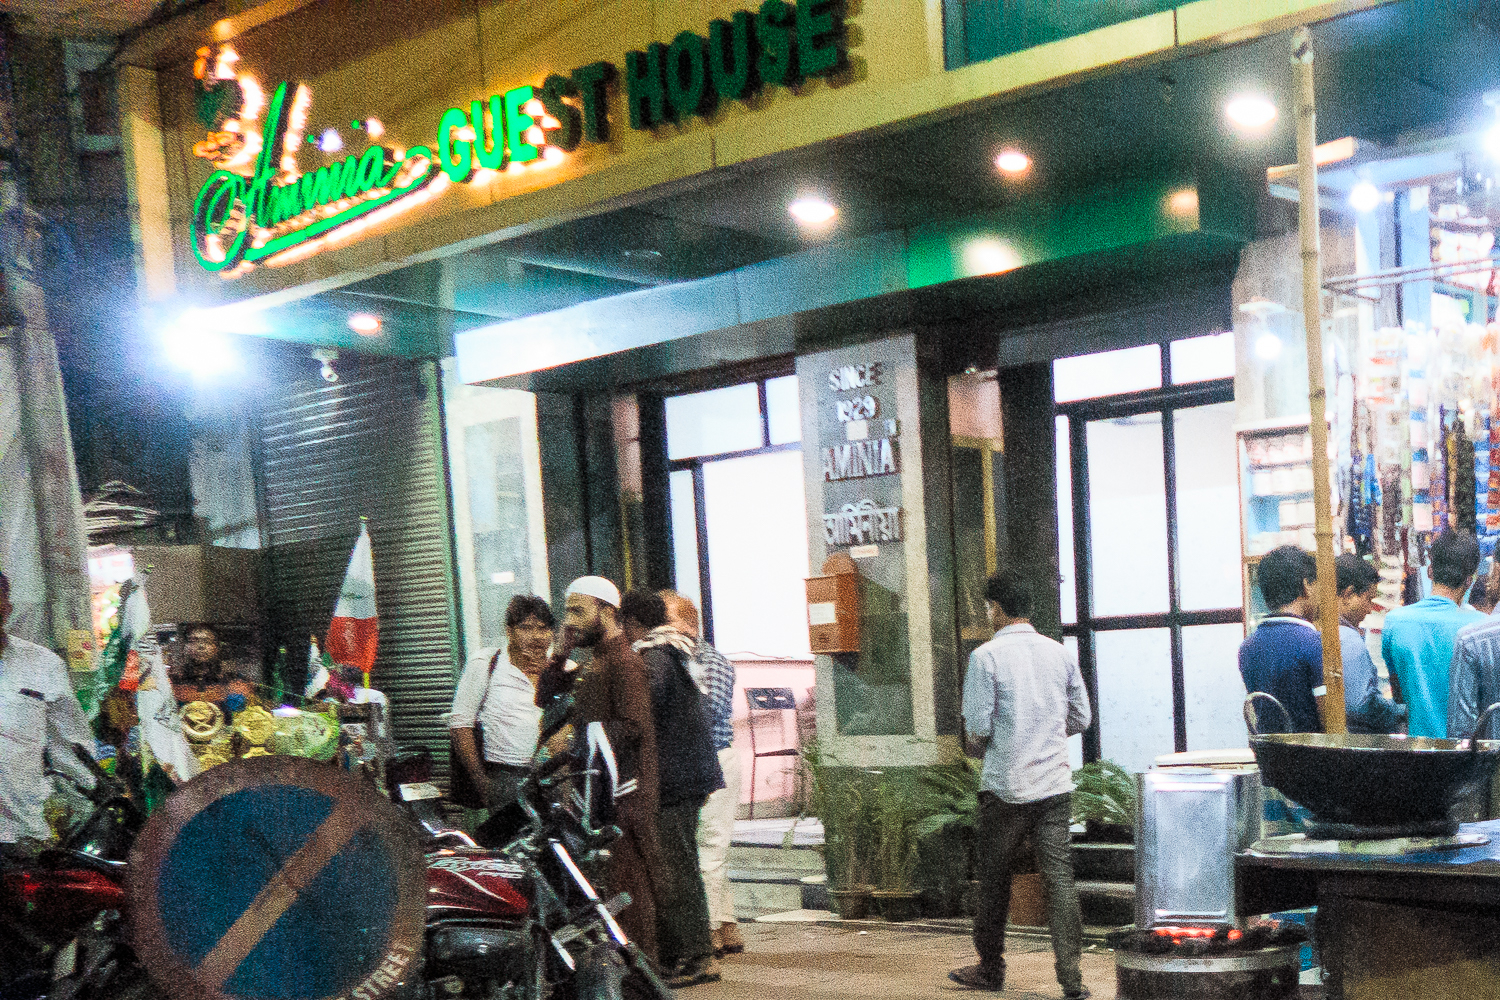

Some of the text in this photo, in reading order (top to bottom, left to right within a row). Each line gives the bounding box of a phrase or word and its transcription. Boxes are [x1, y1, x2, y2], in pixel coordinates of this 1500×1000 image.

[437, 60, 618, 183] GUEST
[625, 0, 848, 131] HOUSE
[828, 362, 881, 392] SINCE
[822, 438, 898, 481] AMINIA
